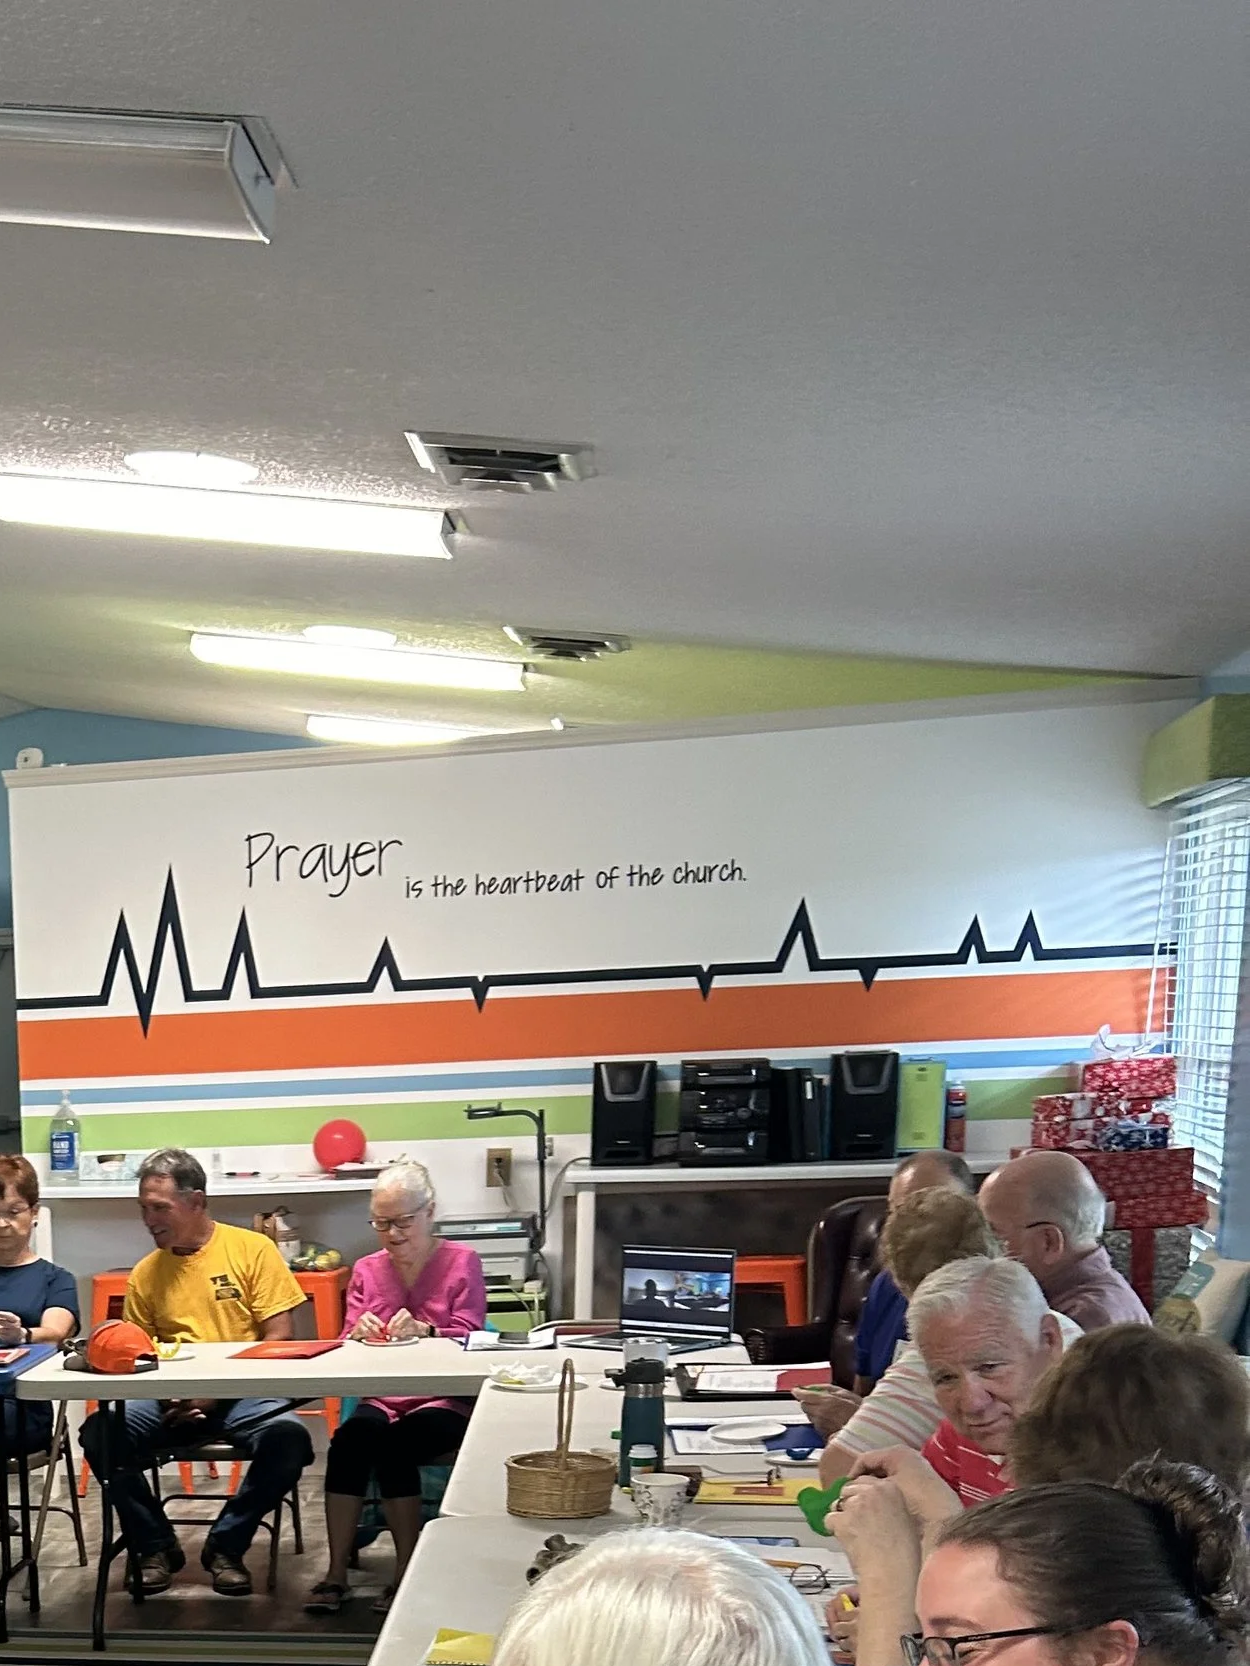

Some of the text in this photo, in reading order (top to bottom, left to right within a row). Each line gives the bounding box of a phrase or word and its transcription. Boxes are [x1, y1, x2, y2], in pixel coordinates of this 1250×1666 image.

[244, 831, 403, 898] Prayer
[405, 858, 748, 899] is the heartbeat of the church.
